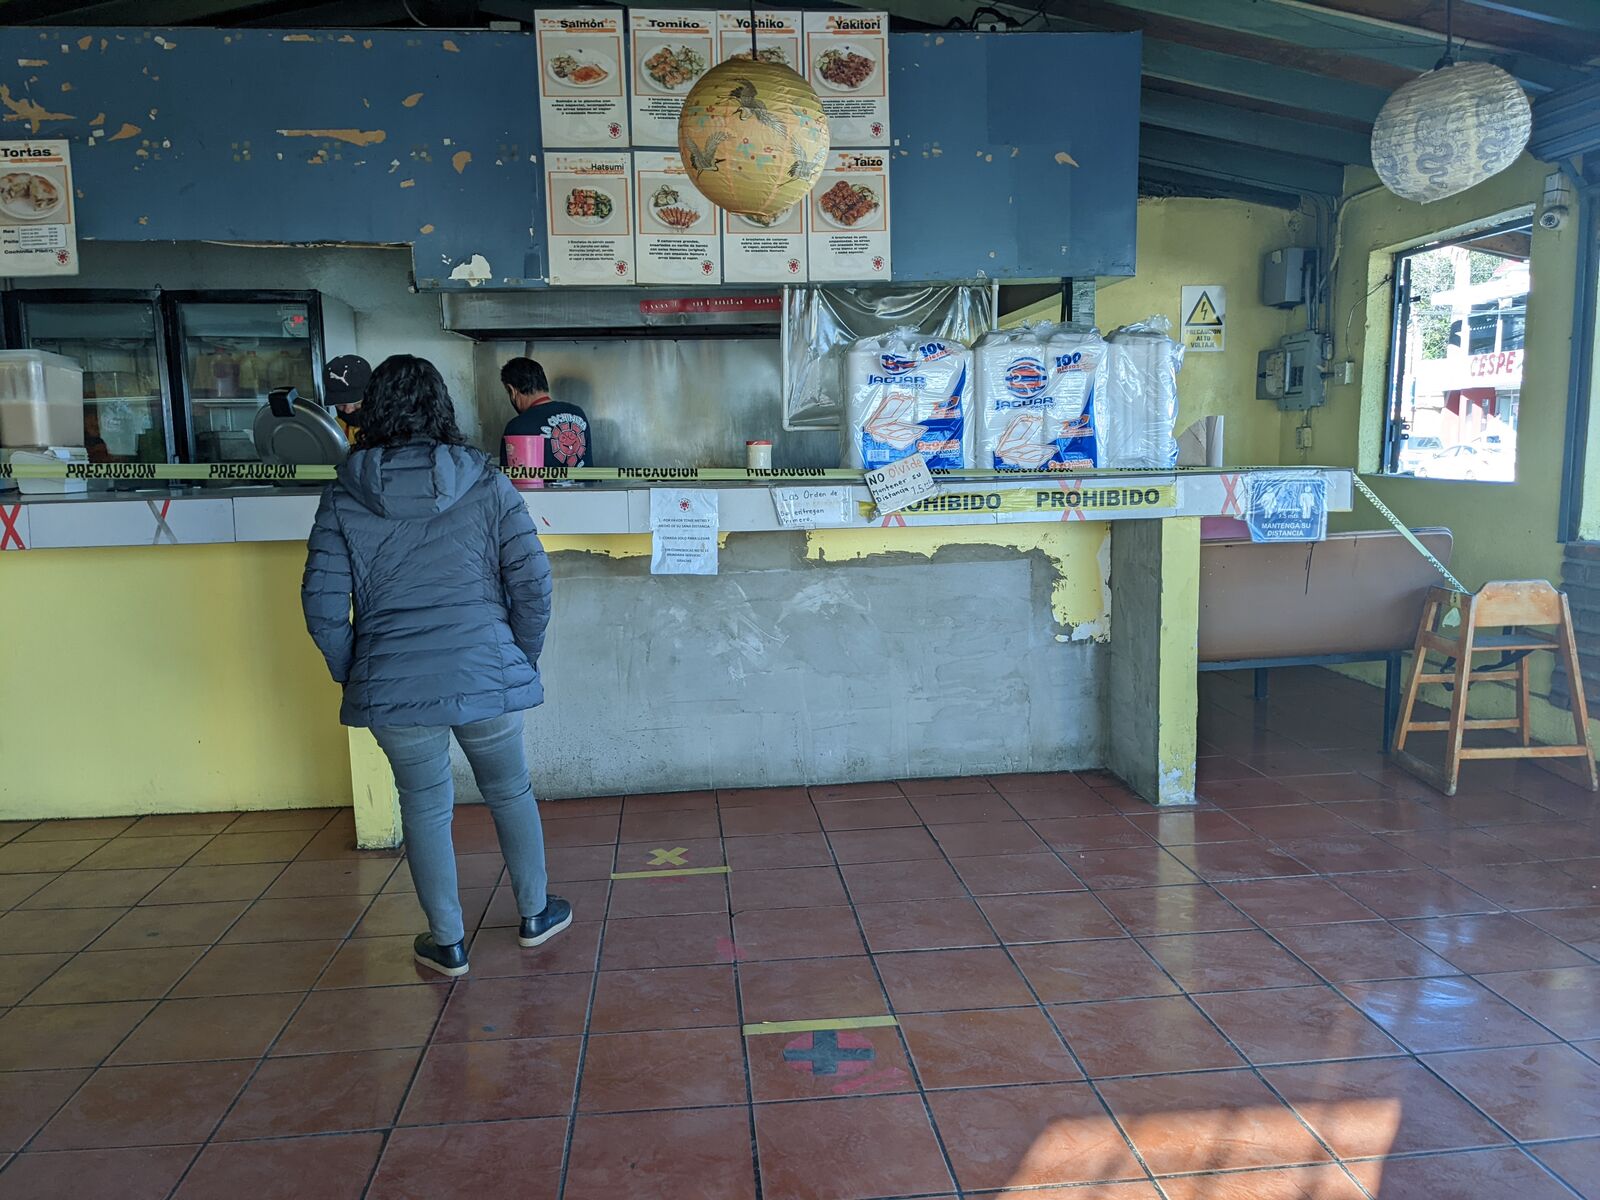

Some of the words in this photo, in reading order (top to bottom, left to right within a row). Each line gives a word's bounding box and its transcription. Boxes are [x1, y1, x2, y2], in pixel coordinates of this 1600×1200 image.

[560, 18, 604, 28] Salmón
[649, 19, 700, 28] Tomiko
[736, 18, 784, 28] Yoshiko
[836, 19, 881, 29] Yakitori
[1, 147, 52, 157] Tortas
[591, 162, 624, 171] Hatsumi
[854, 157, 883, 166] Taizo
[1055, 352, 1082, 368] 100
[1471, 351, 1516, 377] CESPE
[868, 374, 925, 385] JAGUAR
[995, 397, 1054, 410] JAGUAR
[547, 413, 587, 431] COCHINITA
[65, 463, 156, 479] PRECAUCION
[208, 463, 297, 479] PRECAUCION
[617, 467, 698, 478] PRECAUCION
[868, 472, 885, 486] NO
[872, 478, 907, 496] Mantener
[781, 491, 800, 502] Las
[803, 490, 827, 500] Orden
[876, 486, 909, 503] Distancia
[1036, 488, 1160, 508] PROHIBIDO
[794, 508, 825, 517] entregan
[1267, 529, 1304, 537] DISTANCIA
